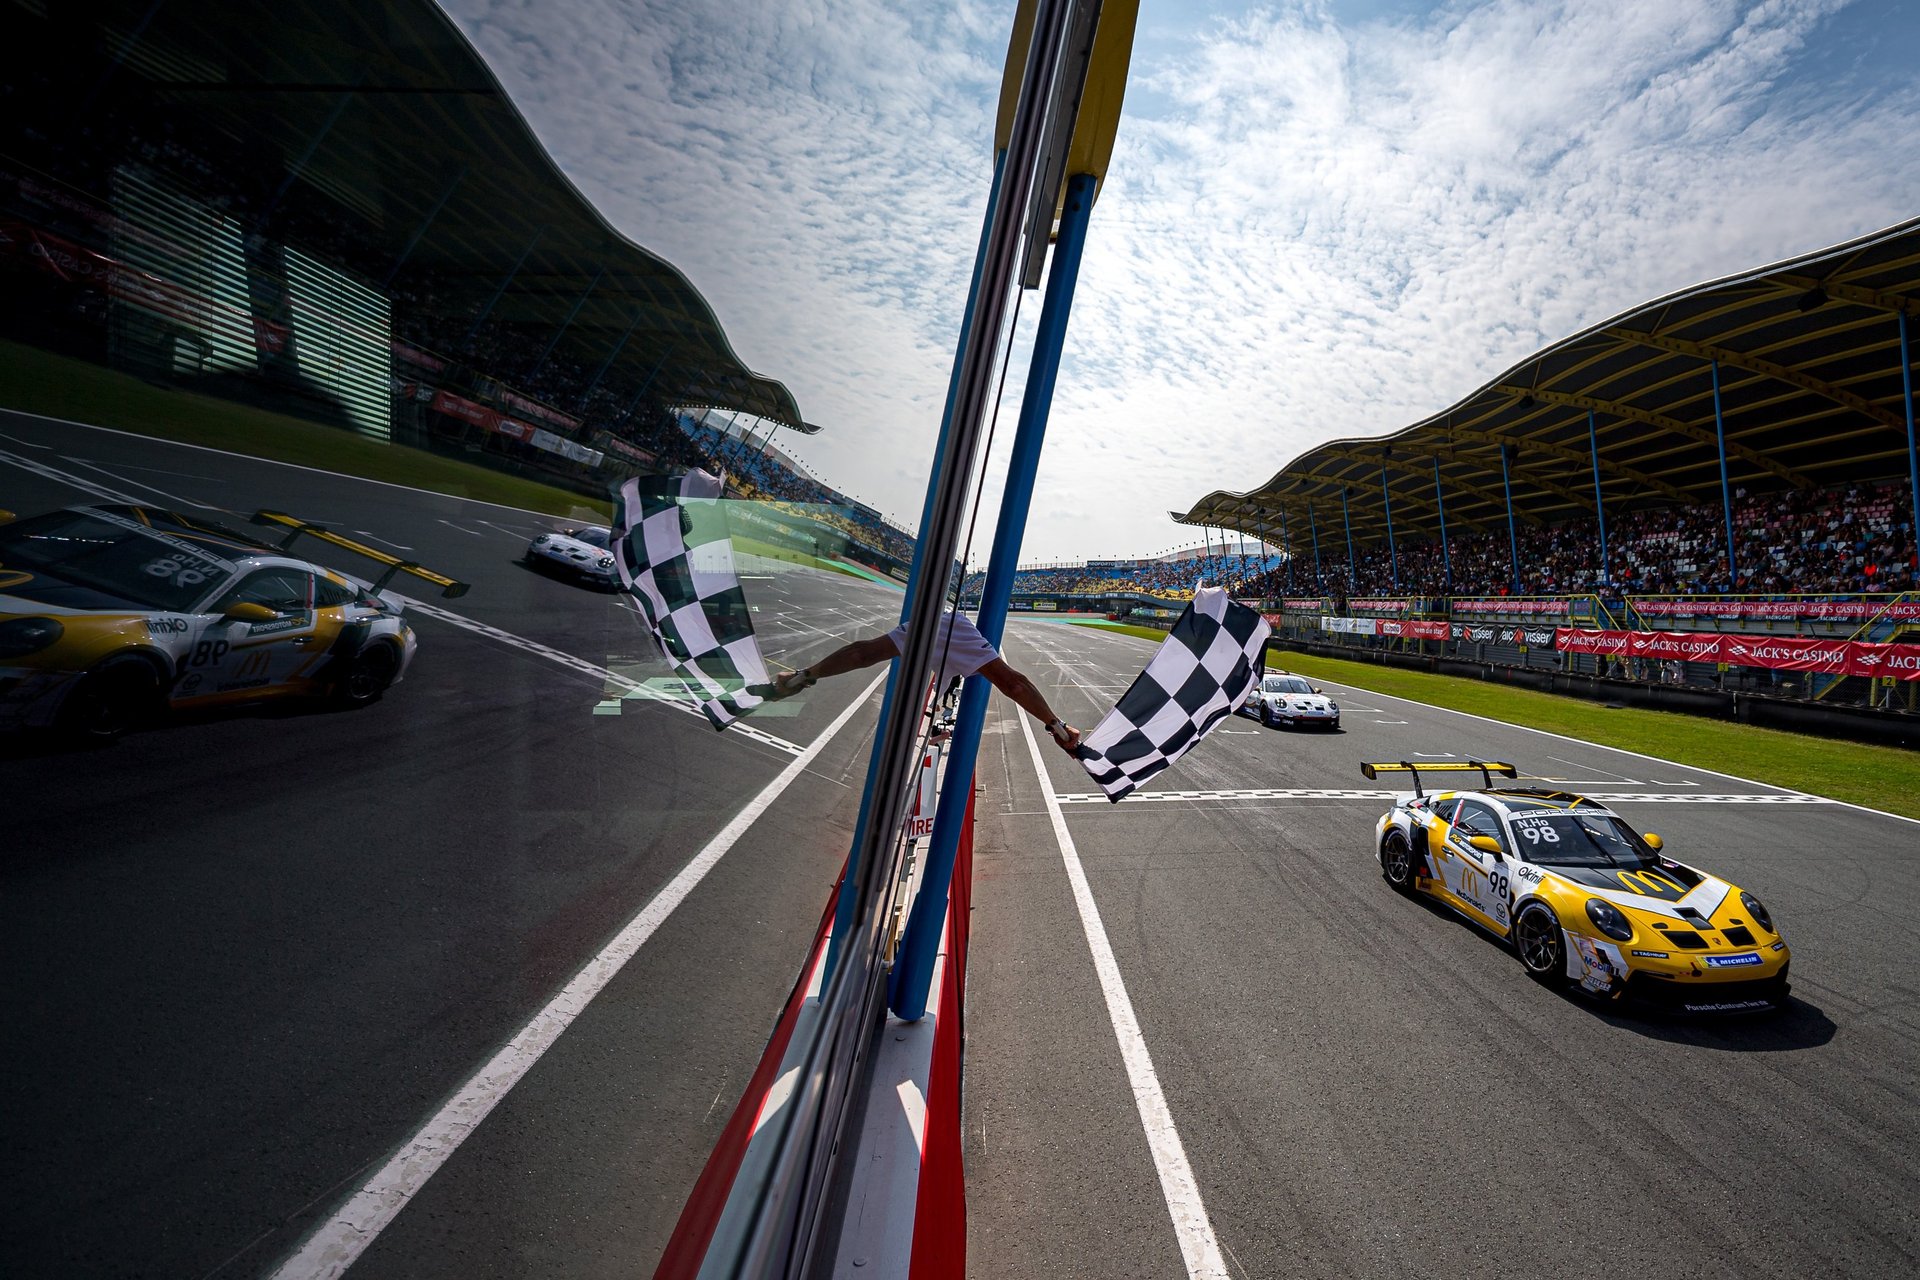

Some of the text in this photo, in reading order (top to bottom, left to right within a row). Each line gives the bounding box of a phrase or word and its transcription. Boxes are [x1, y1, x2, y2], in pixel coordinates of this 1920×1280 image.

[1709, 603, 1754, 612] JACK'S CASINO
[1757, 603, 1806, 612] JACK'S CASINO
[1809, 605, 1865, 614] JACK'S CASINO
[1571, 636, 1627, 648] JACK'S CASINO
[1649, 640, 1720, 653] JACK'S CASINO
[1750, 646, 1844, 663] JACK'S CASINO
[1886, 677, 1893, 685] 2
[1517, 818, 1549, 829] N.Ho
[1522, 827, 1560, 845] 98
[1489, 871, 1508, 899] 98
[1456, 888, 1486, 913] McDonald's
[1584, 955, 1611, 973] Mobil
[1719, 956, 1758, 965] MICHELIN
